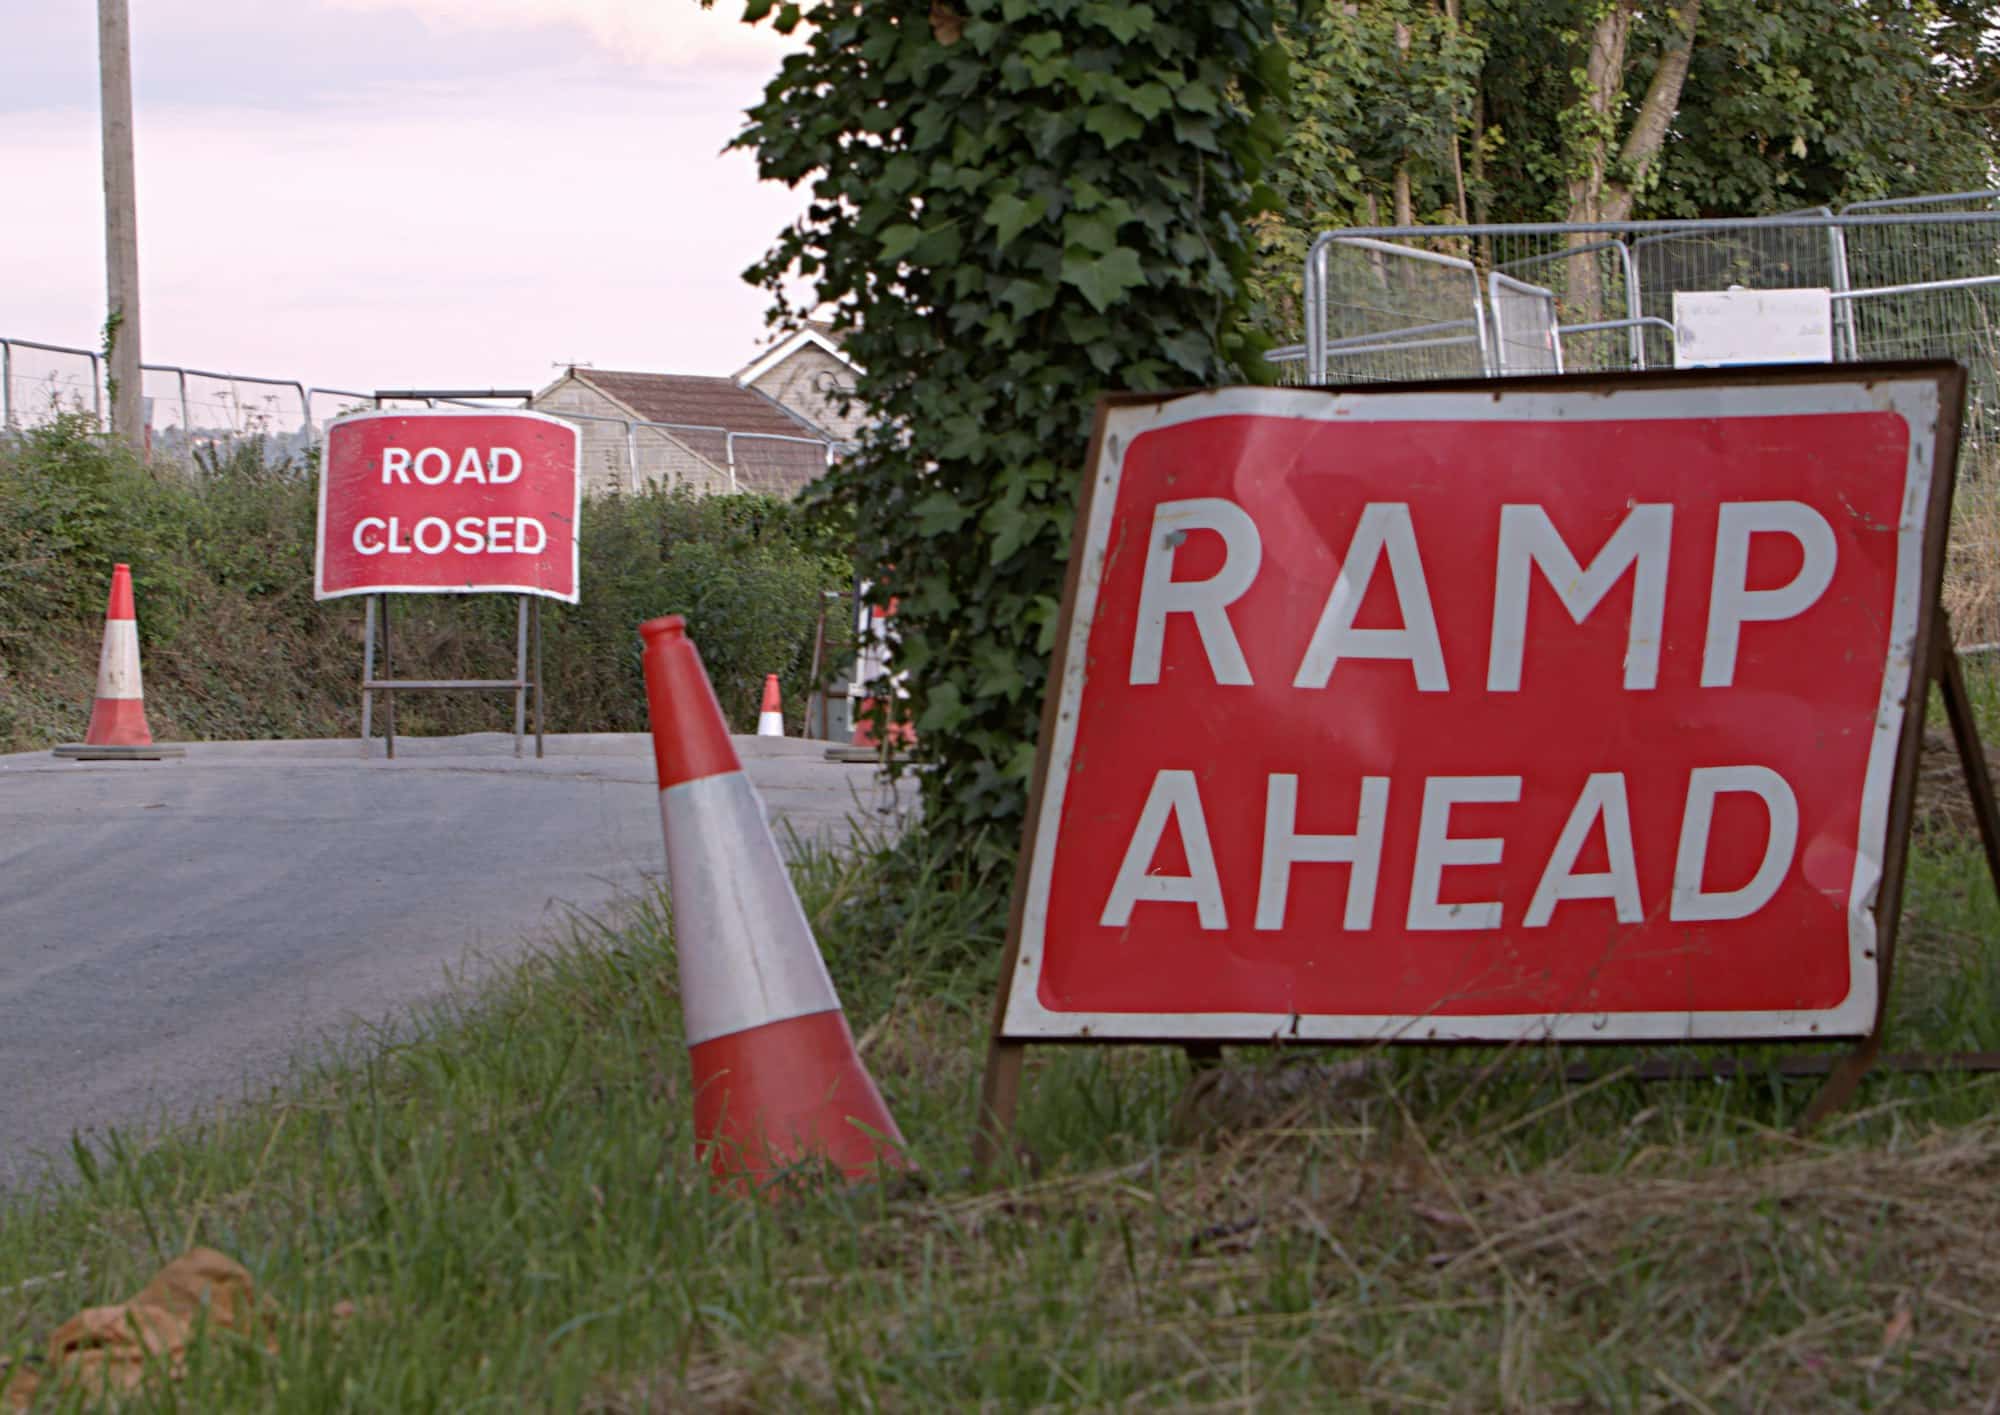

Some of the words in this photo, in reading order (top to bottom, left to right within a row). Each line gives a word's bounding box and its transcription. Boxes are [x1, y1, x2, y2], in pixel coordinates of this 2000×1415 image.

[381, 447, 523, 484] ROAD
[352, 516, 547, 555] CLOSED
[1129, 497, 1838, 692] RAMP
[1100, 765, 1800, 932] AHEAD
